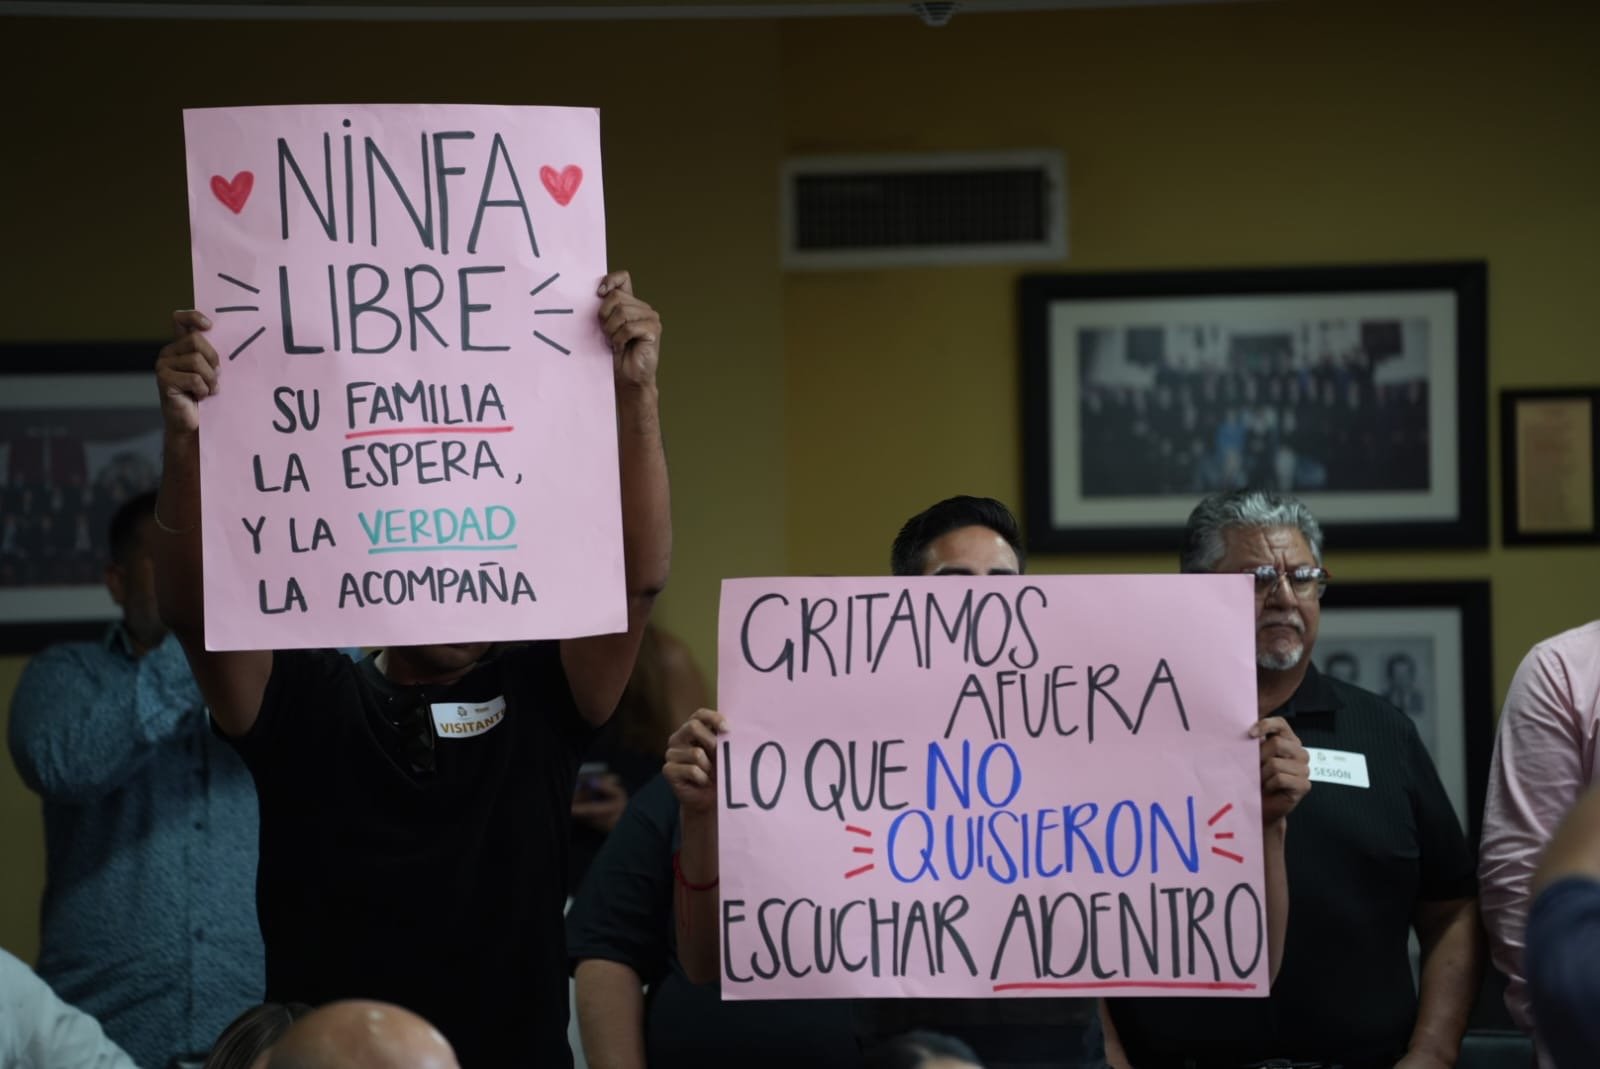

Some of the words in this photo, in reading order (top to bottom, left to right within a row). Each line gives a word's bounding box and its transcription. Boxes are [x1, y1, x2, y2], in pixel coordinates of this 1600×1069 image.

[278, 263, 511, 355] LIBRE
[272, 386, 321, 435] SU
[346, 380, 506, 428] FAMILIA
[253, 453, 311, 493] LA
[341, 440, 523, 490] ESPERA,
[241, 516, 267, 554] Y
[289, 516, 336, 553] LA
[358, 505, 516, 544] VERDAD
[259, 577, 309, 614] LA
[338, 562, 537, 609] ACOMPAÑA
[741, 586, 1048, 680] GRITAMOS
[944, 657, 1189, 743] AFUERA
[722, 740, 787, 811] LO
[804, 738, 910, 821] QUE
[926, 739, 1022, 810] NO
[885, 796, 1200, 885] QUISIERON
[721, 895, 978, 983] ESCUCHAR
[990, 881, 1264, 981] ADENTRO
